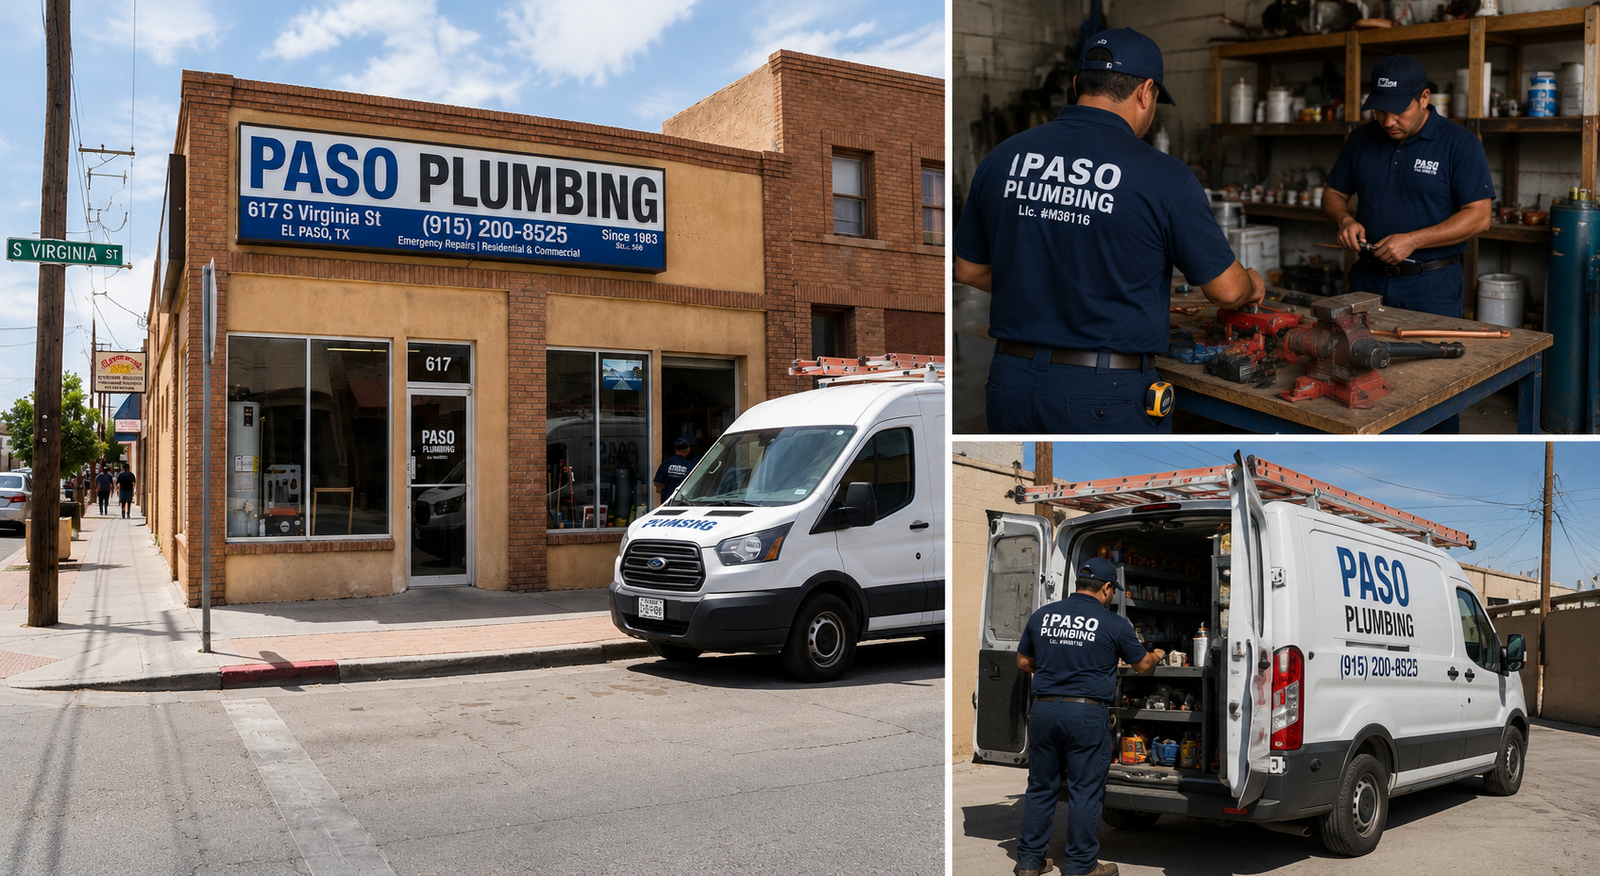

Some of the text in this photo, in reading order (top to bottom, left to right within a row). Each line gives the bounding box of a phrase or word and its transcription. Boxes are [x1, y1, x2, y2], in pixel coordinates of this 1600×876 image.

[249, 136, 658, 223] PASO PLUMBING
[1003, 180, 1114, 214] PLUMBING
[248, 201, 382, 226] 617 S Virginia St
[281, 224, 350, 241] EL PASO, TX
[423, 214, 568, 243] (915) 200-8525
[602, 229, 658, 244] Since 1983
[13, 242, 119, 261] S VIRGINIA ST
[398, 235, 443, 250] Emergency
[445, 239, 475, 251] Repairs
[482, 241, 525, 254] Residential
[526, 245, 533, 254] &
[425, 356, 452, 372] 617
[422, 429, 455, 444] PASO
[1336, 545, 1410, 608] PASO
[1344, 604, 1415, 638] PLUMBING
[1040, 627, 1096, 642] PLUMBING
[1340, 654, 1369, 681] (915)
